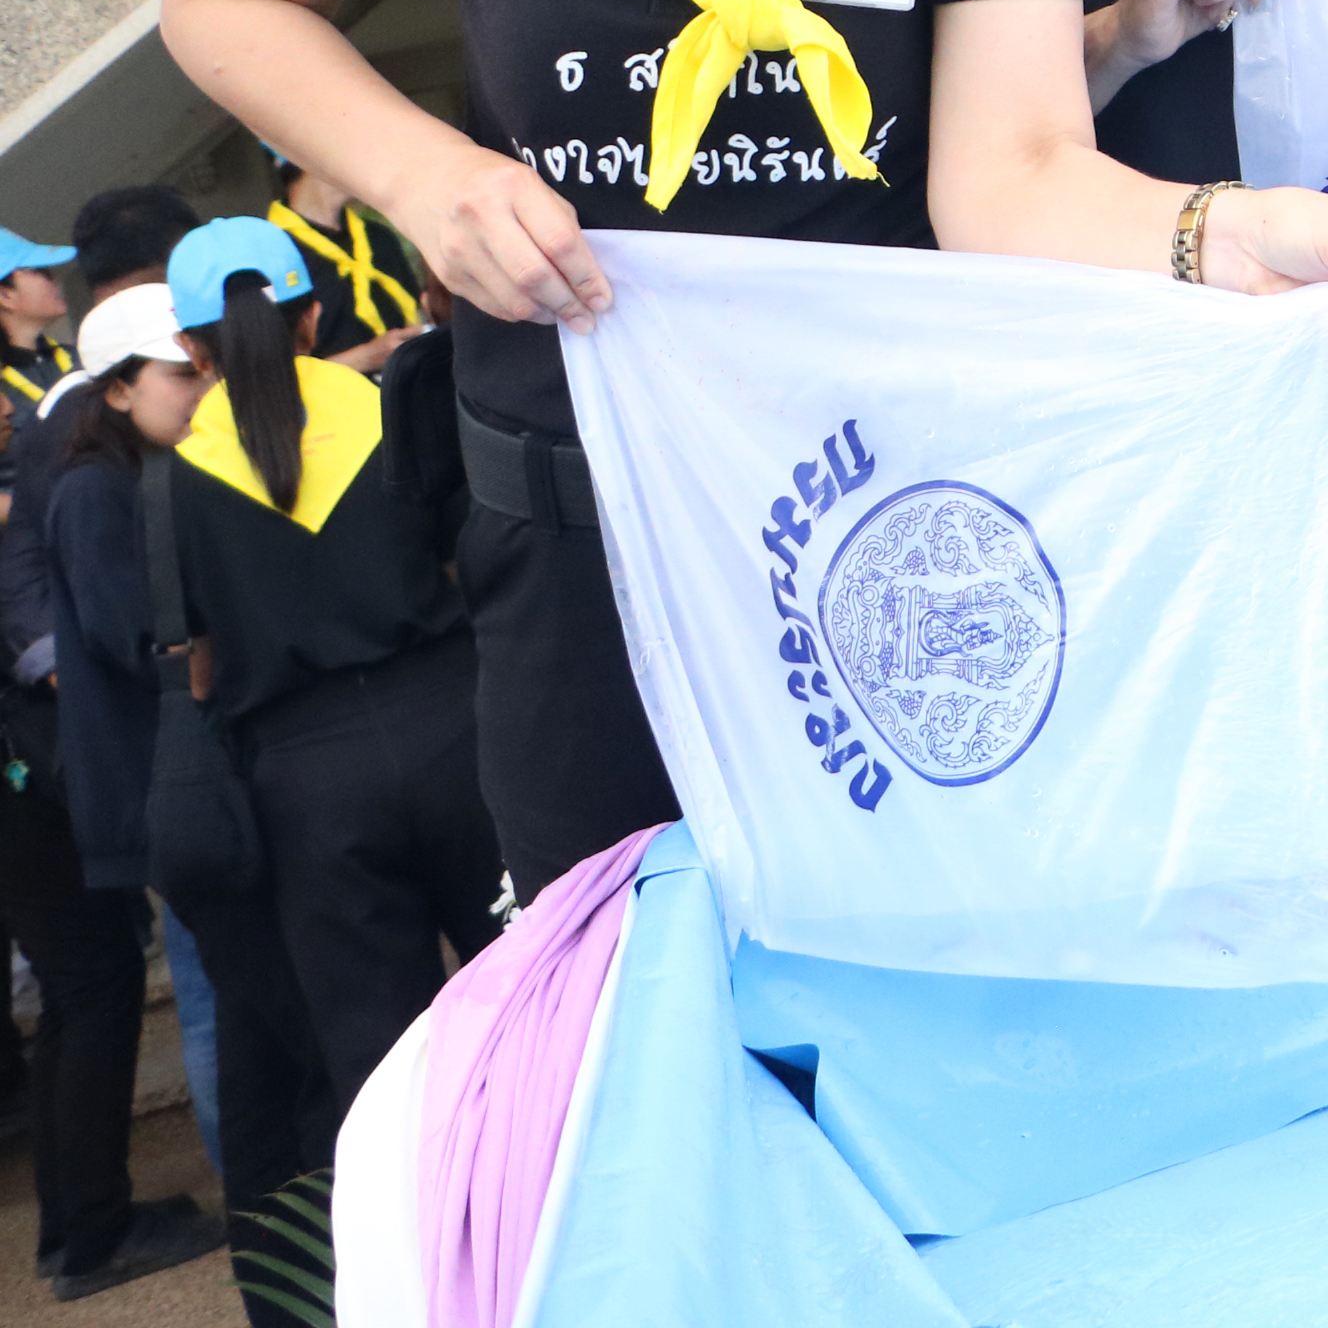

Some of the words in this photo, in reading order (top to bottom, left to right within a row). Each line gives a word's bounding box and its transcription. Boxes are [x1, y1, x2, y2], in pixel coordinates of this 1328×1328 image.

[556, 51, 588, 92] ธ
[762, 419, 893, 813] กรมประมง
